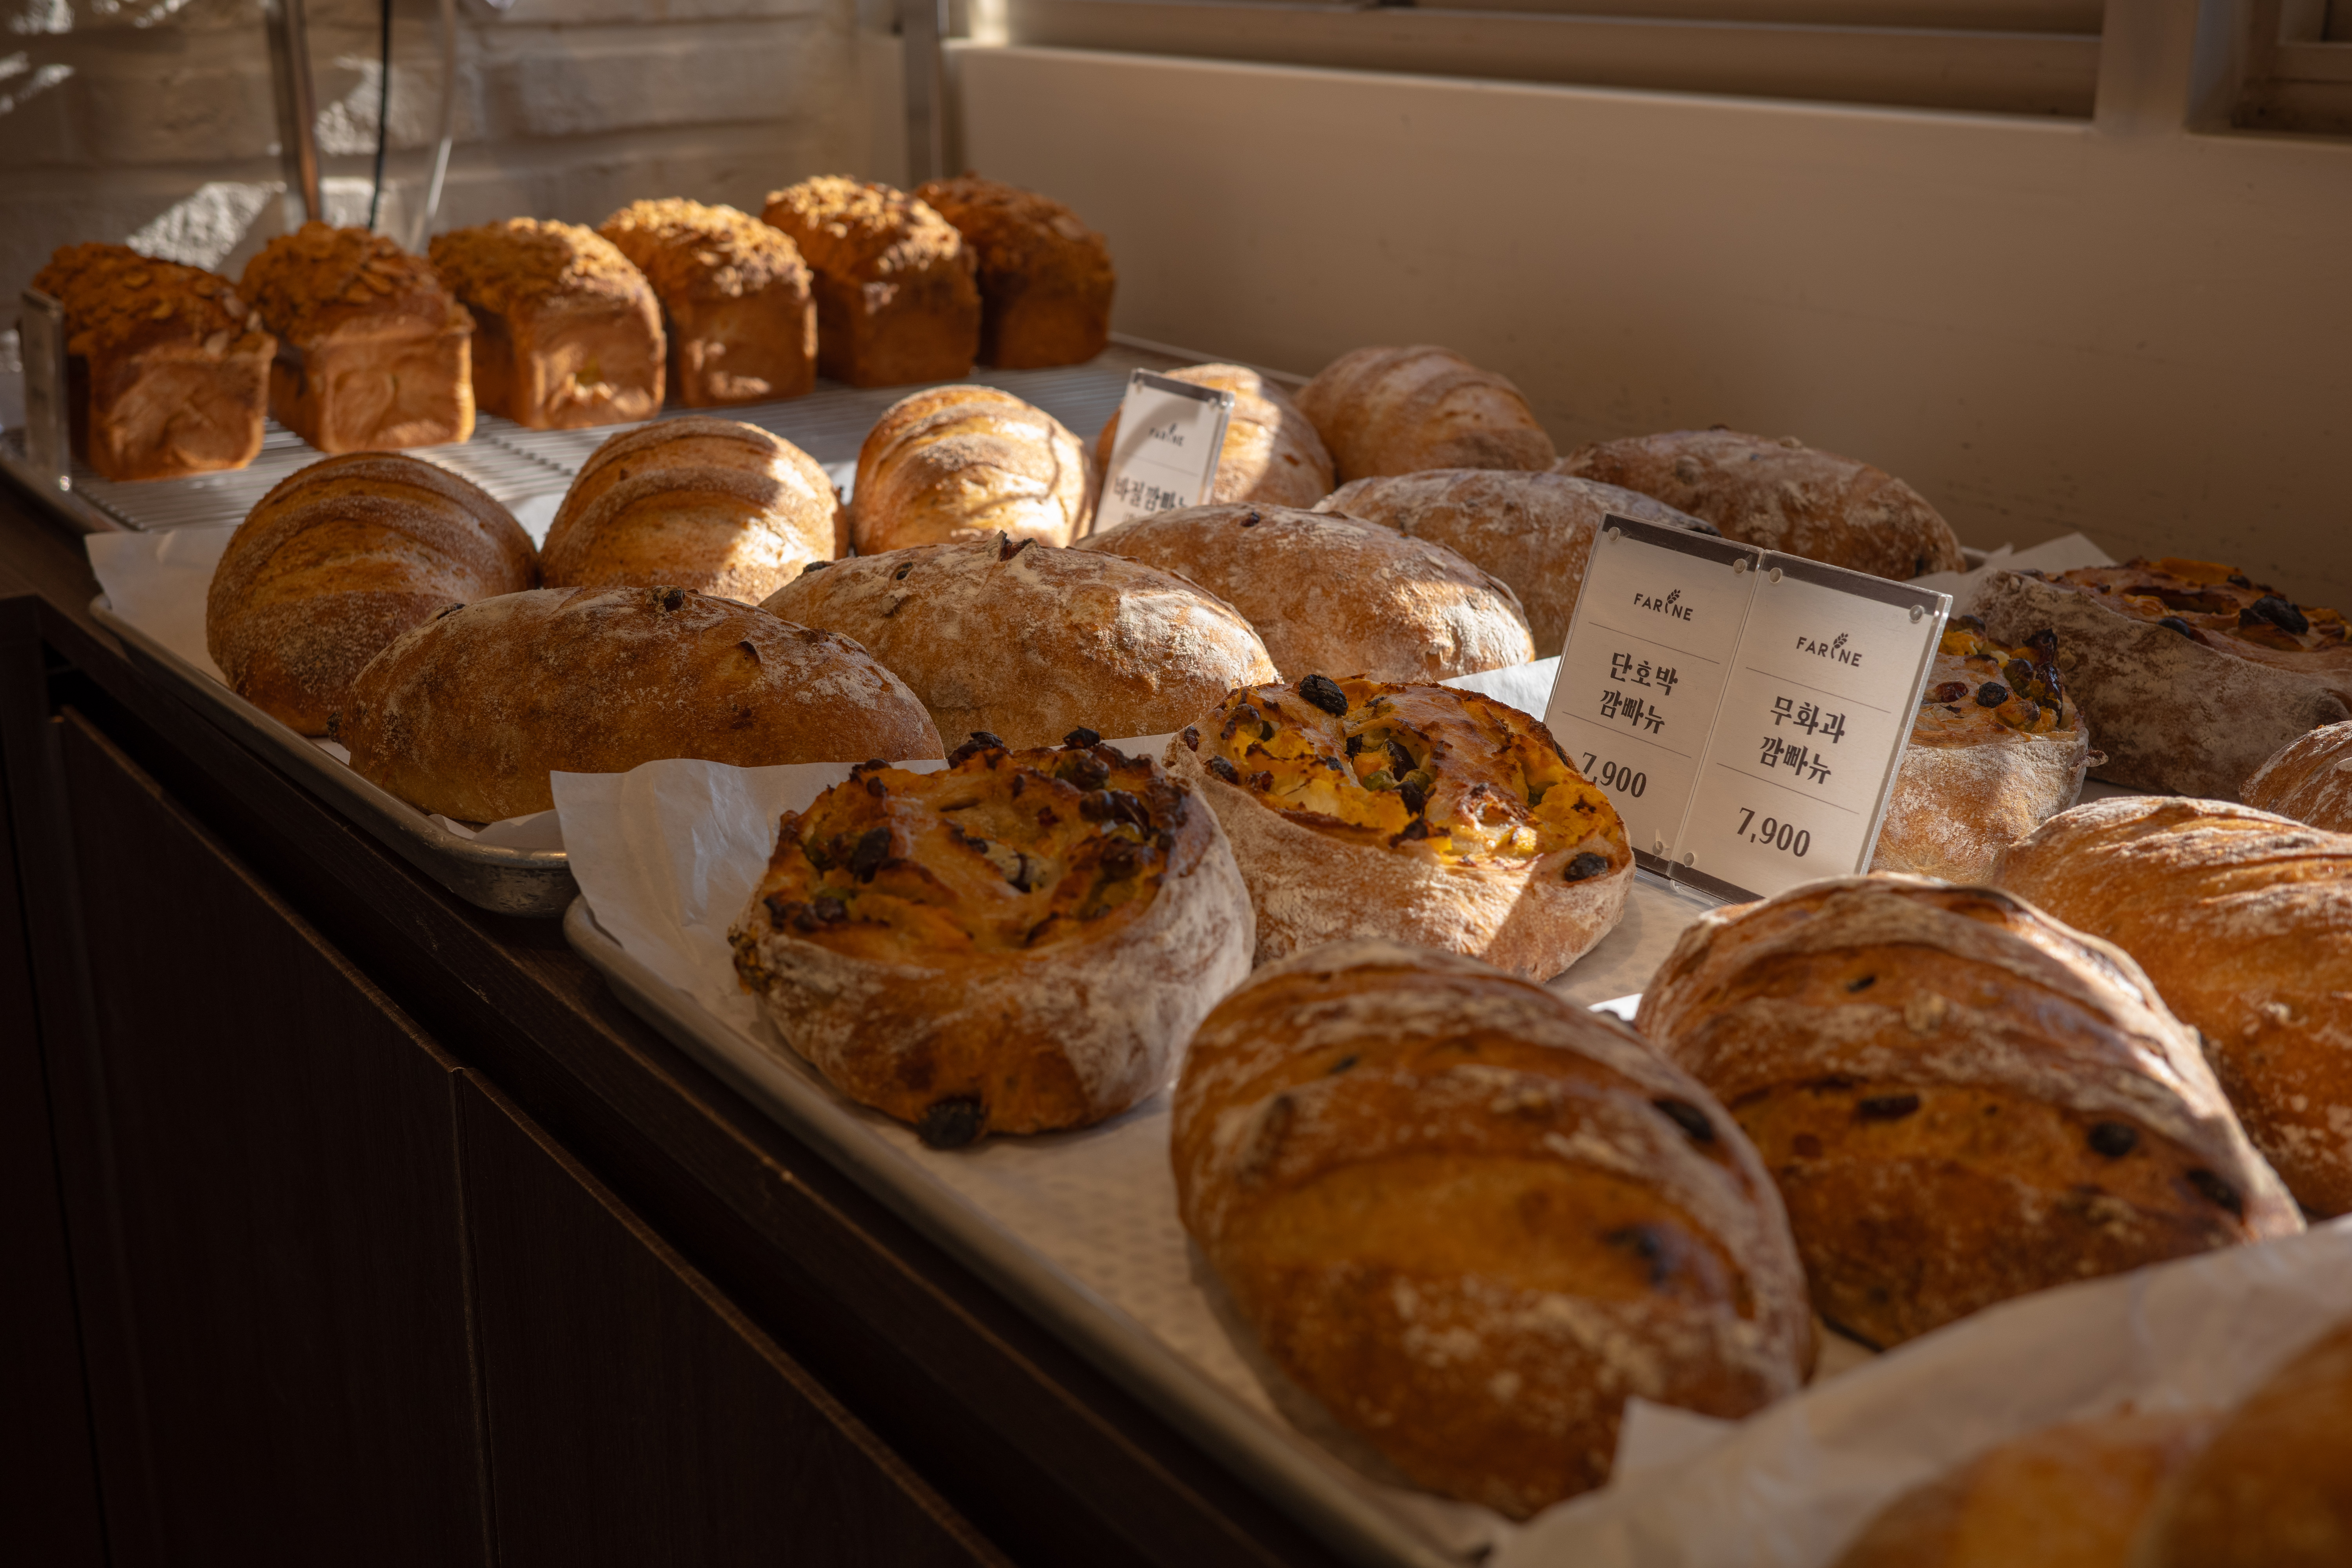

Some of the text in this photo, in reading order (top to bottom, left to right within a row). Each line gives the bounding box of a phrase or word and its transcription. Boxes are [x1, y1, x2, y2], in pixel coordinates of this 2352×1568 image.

[1633, 589, 1693, 621] FARINE
[1796, 633, 1862, 667] FARINE
[1610, 652, 1678, 696] 단호박
[1600, 690, 1665, 734] 깜빠뉴
[1770, 696, 1846, 744] 무화과
[1583, 752, 1646, 798] 7,900
[1759, 736, 1831, 784] 깜빠뉴
[1737, 807, 1810, 857] 7,900
